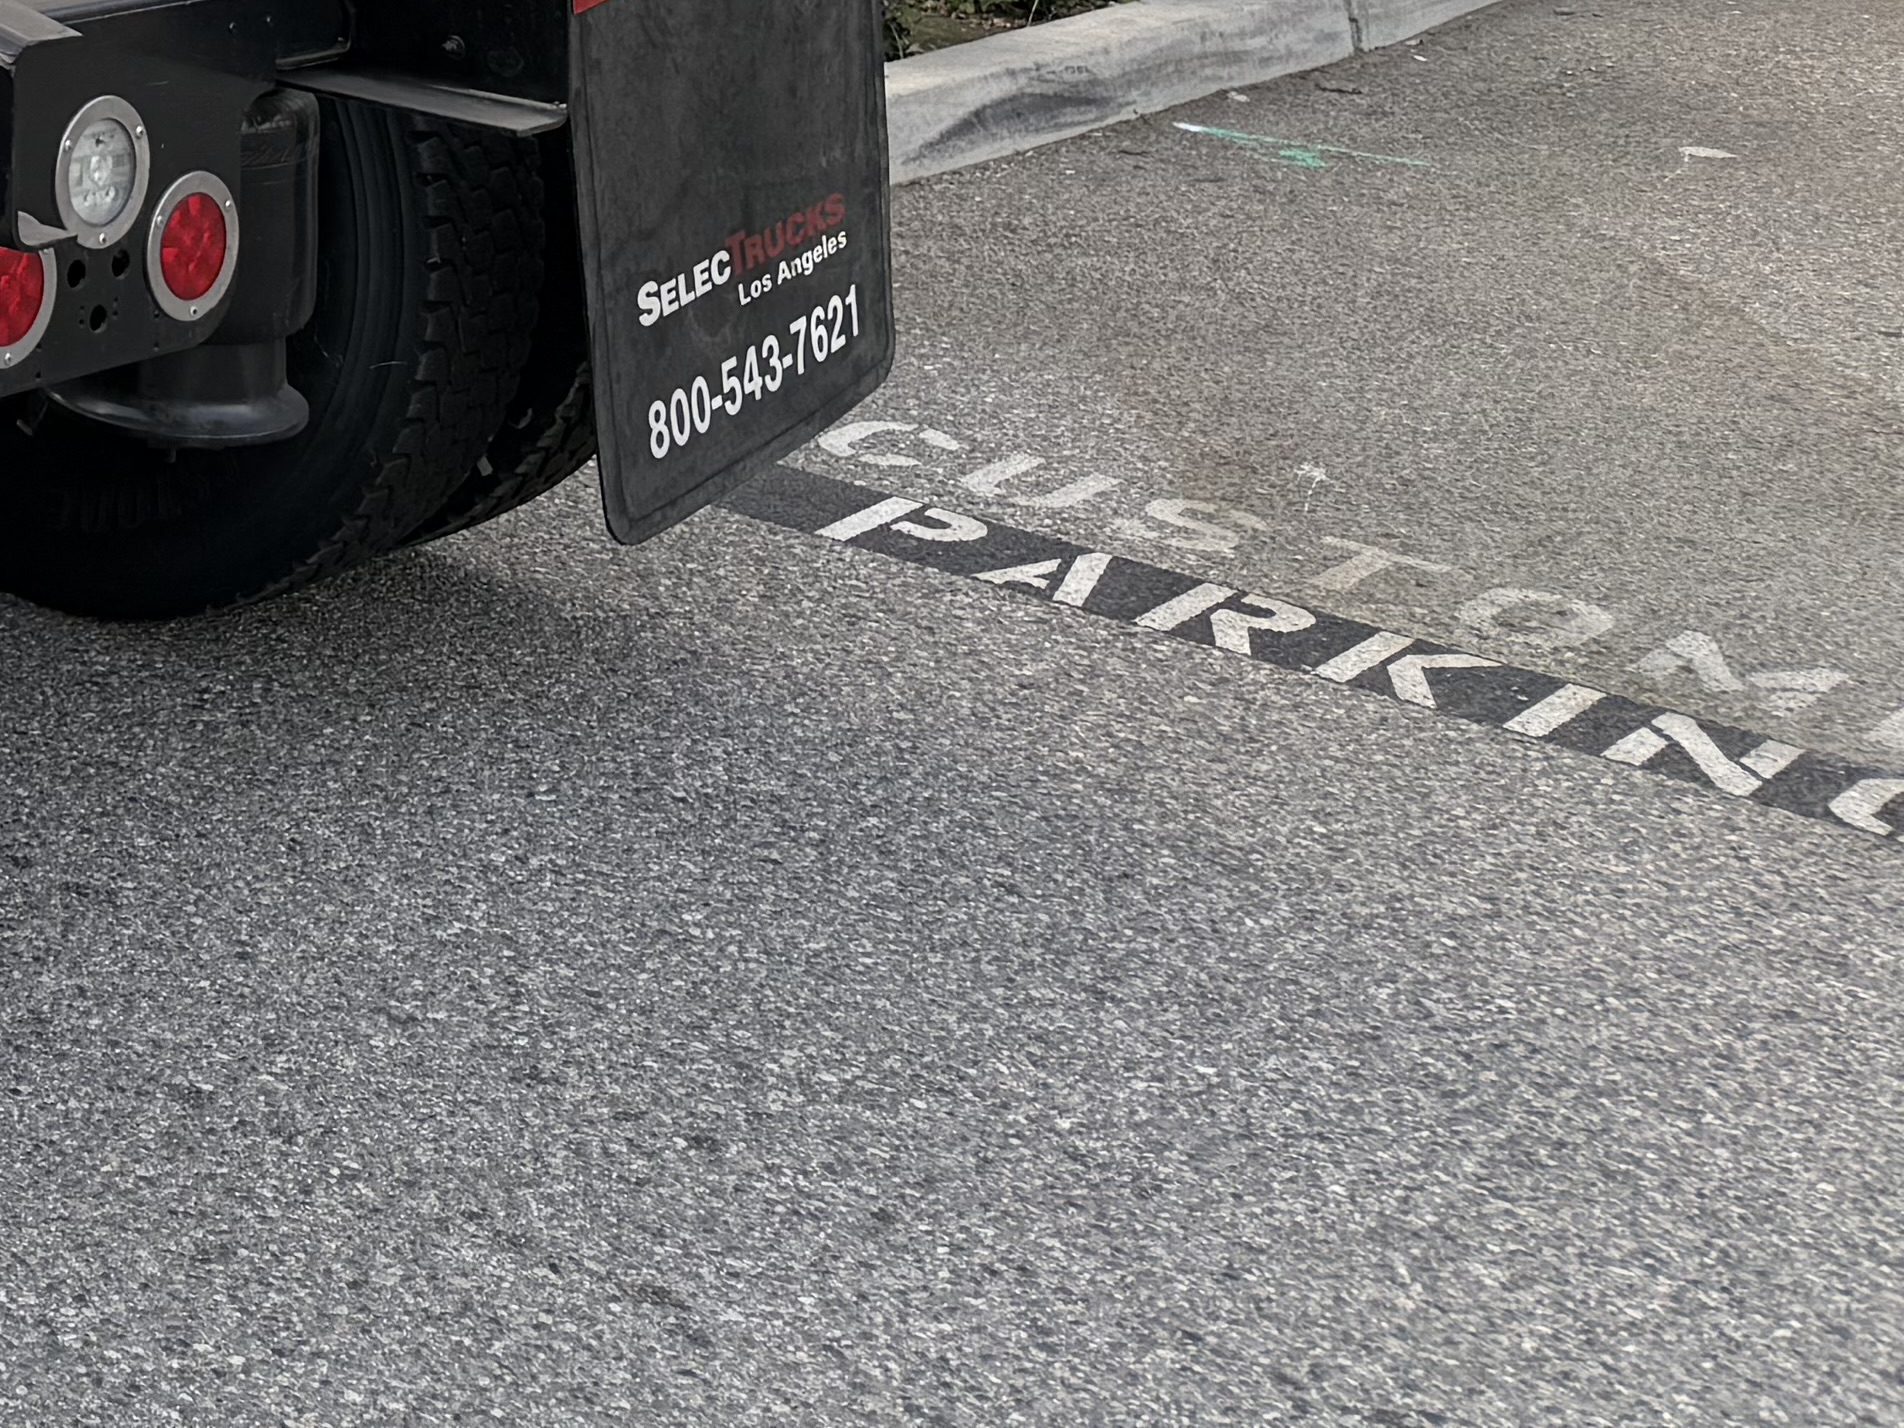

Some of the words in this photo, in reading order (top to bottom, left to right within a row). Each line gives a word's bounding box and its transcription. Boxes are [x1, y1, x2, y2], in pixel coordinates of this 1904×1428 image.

[637, 192, 845, 327] SELECTRUCKS
[737, 273, 773, 306] Los
[777, 231, 847, 286] Angeles
[648, 283, 859, 459] 800-543-7621
[817, 419, 1904, 749] CUSTOM
